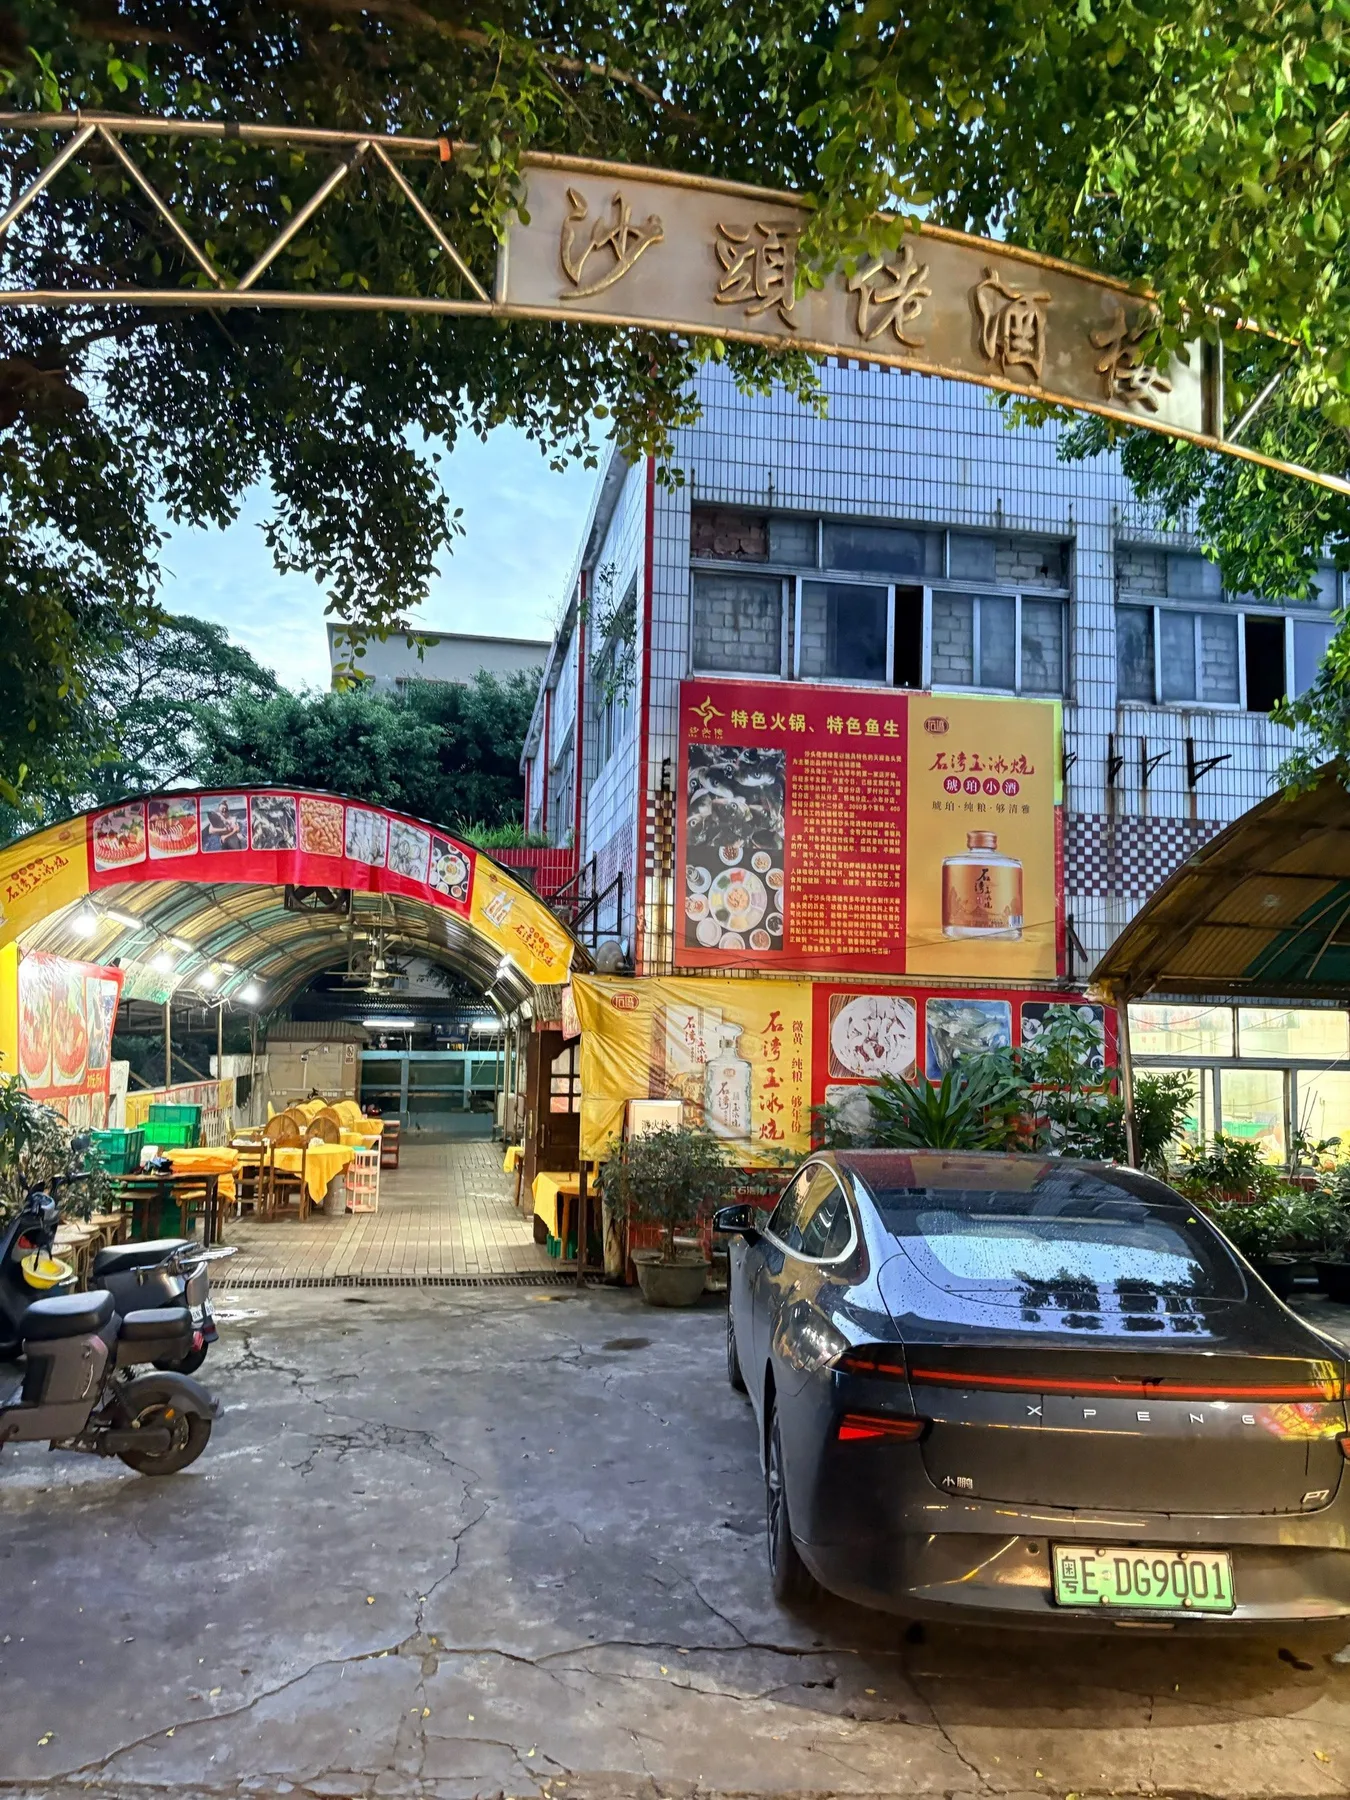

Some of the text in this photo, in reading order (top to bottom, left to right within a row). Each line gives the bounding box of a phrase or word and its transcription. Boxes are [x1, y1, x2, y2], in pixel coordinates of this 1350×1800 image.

[731, 709, 900, 738] 特色火锅、特色鱼生
[928, 751, 1035, 775] 石湾玉冰烧
[945, 778, 1018, 795] 琥珀小酒
[760, 1010, 785, 1140] 石湾玉冰烧
[1027, 1404, 1255, 1425] XPENG
[942, 1475, 974, 1490] 小鹏
